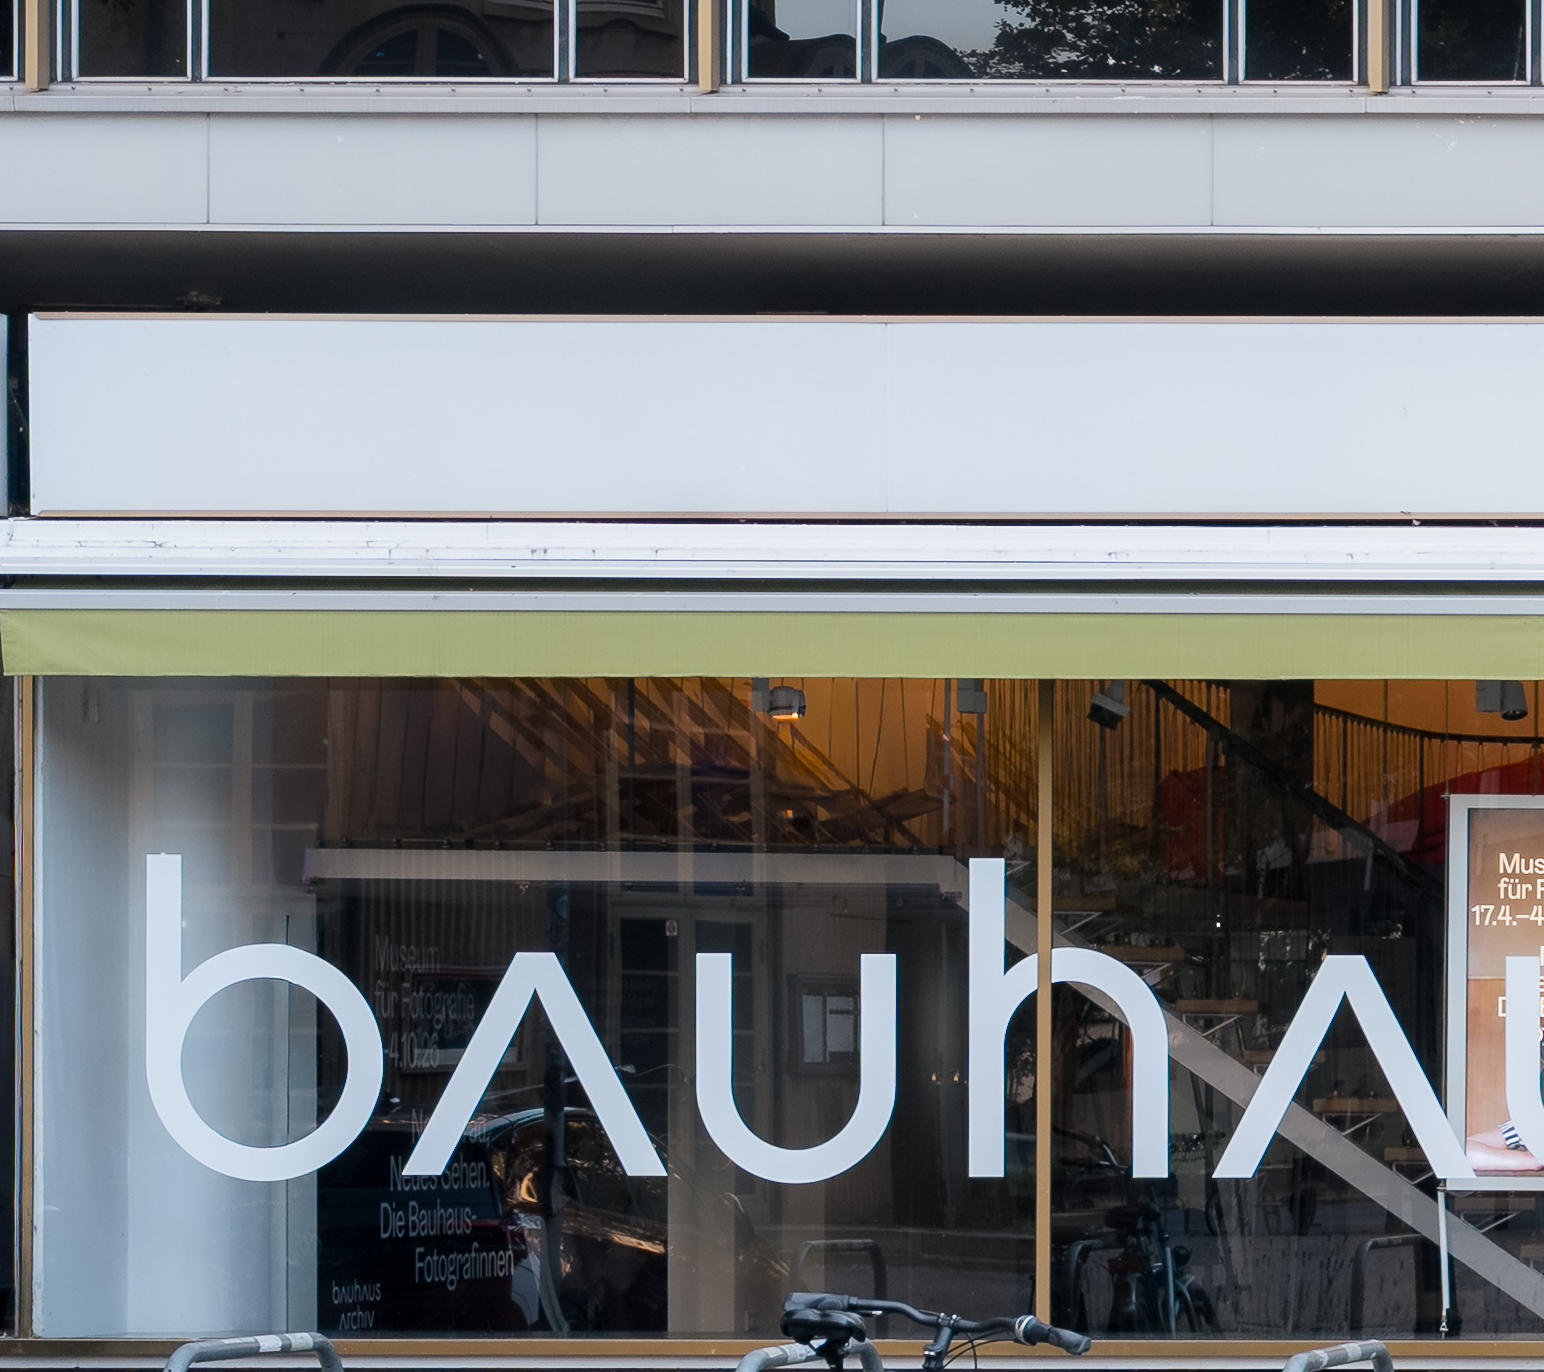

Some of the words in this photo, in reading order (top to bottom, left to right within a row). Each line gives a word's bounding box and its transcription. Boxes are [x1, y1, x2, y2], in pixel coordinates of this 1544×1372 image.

[1498, 878, 1533, 900] für
[374, 934, 440, 973] Museum
[375, 980, 398, 1018] für
[401, 983, 475, 1029] Fotografie
[441, 1152, 490, 1190] Sehen.
[380, 1202, 405, 1239] Die
[409, 1198, 477, 1237] Bauhaus-
[415, 1242, 514, 1290] Fotografinnen
